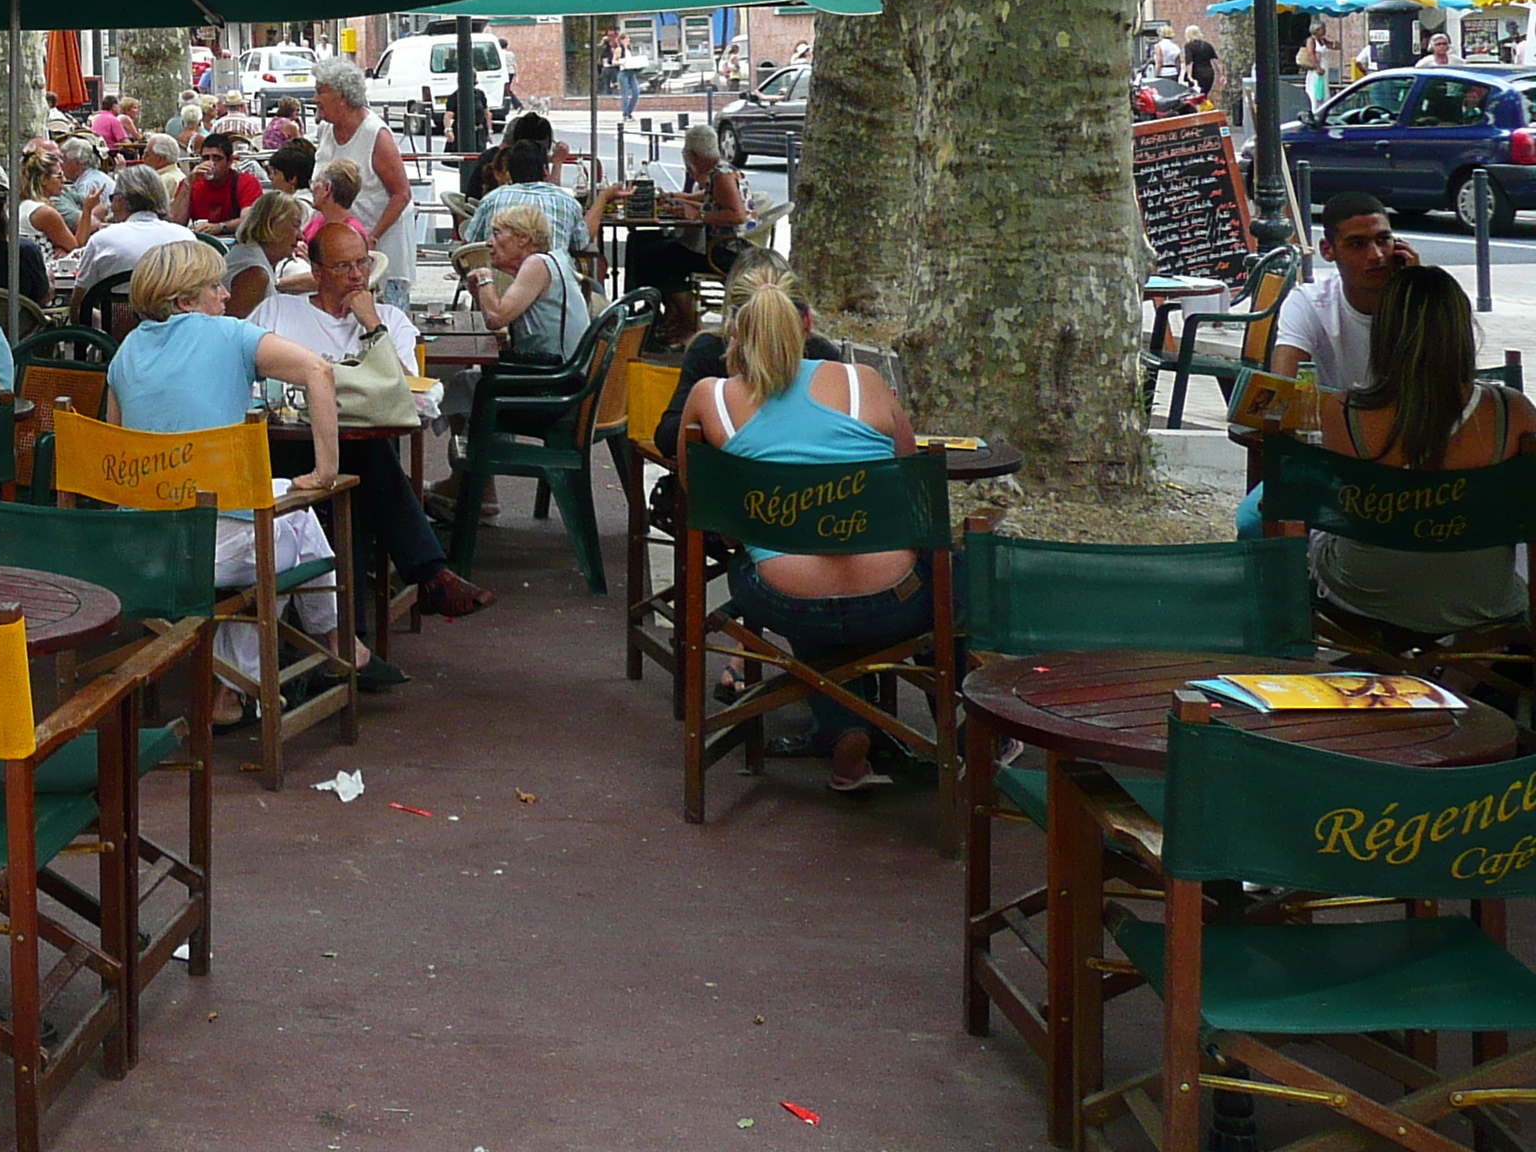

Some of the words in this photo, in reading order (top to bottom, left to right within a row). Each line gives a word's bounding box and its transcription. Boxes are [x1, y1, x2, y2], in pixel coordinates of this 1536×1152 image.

[102, 442, 194, 488] Régence
[156, 477, 197, 506] Café
[744, 469, 867, 527] Régence
[1337, 477, 1467, 524] Régence
[817, 509, 868, 542] Café
[1413, 514, 1468, 542] Café
[1451, 835, 1536, 885] Café
